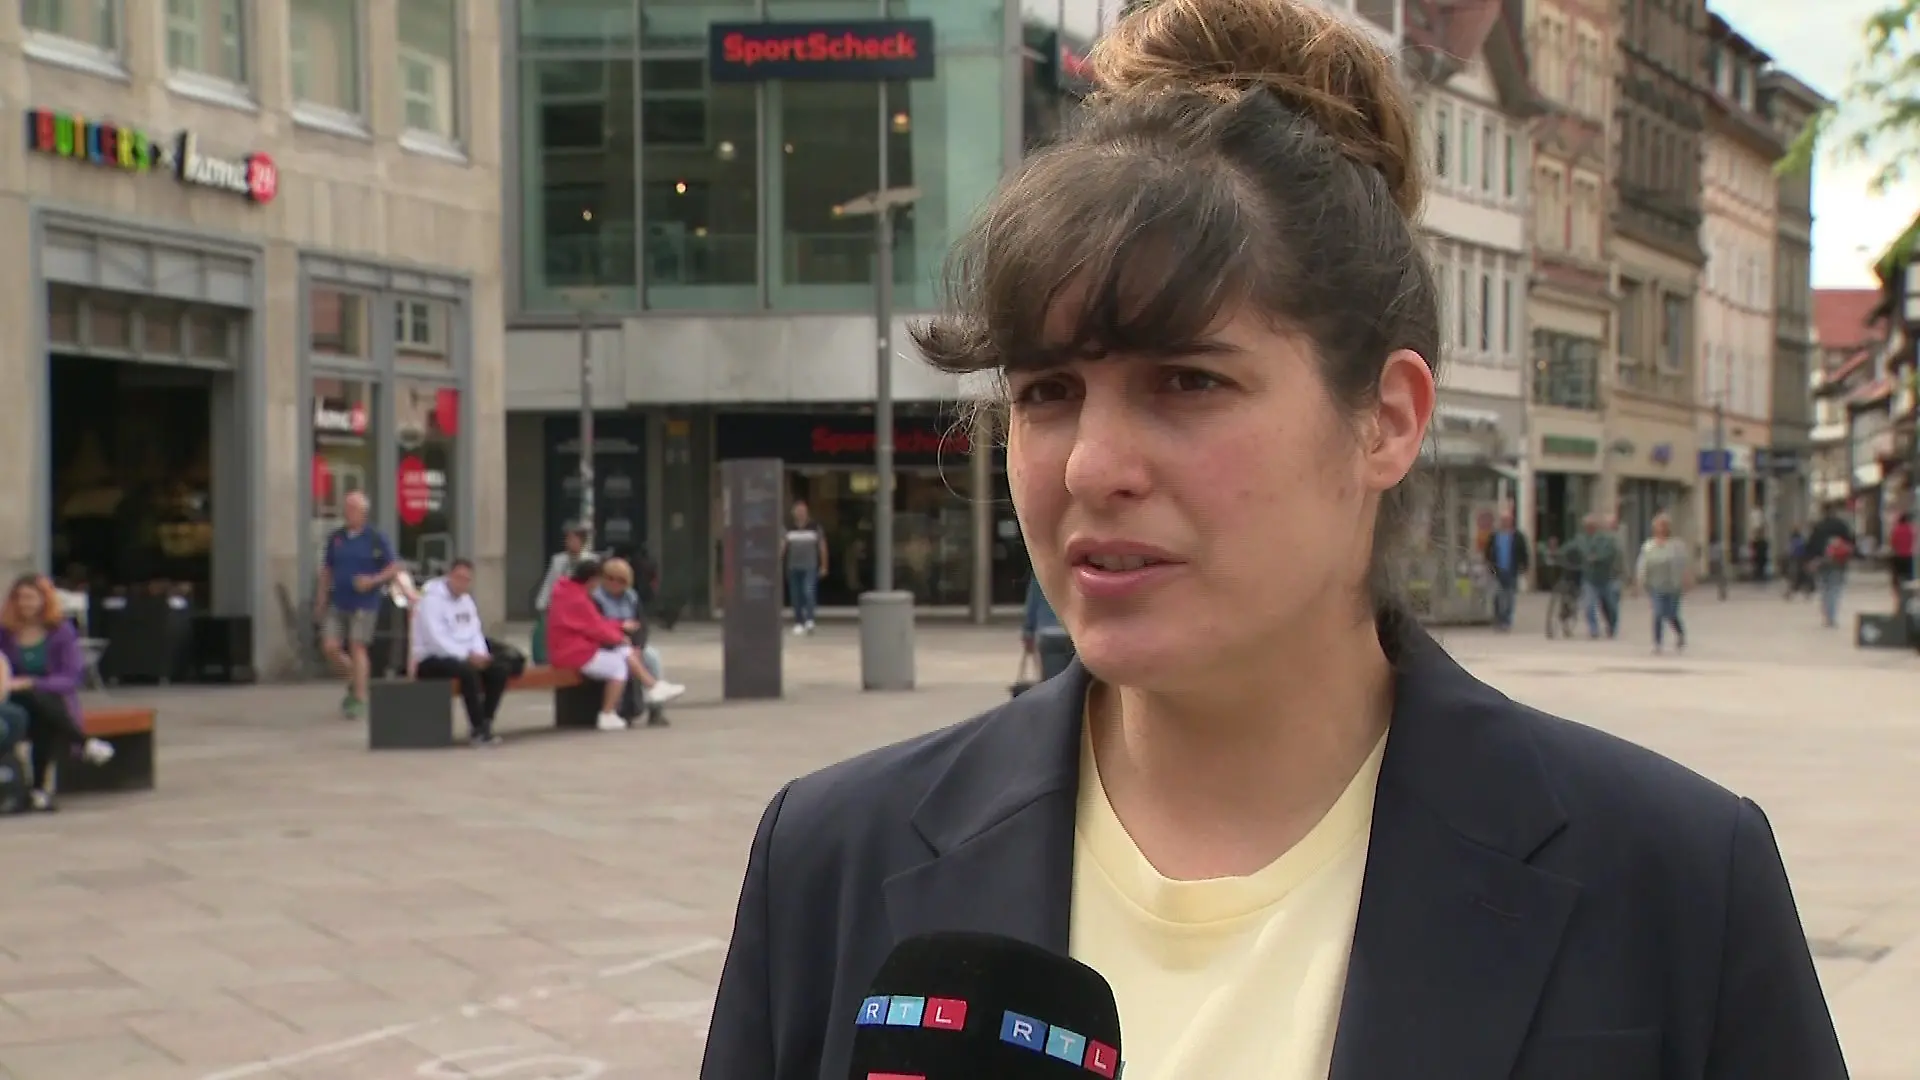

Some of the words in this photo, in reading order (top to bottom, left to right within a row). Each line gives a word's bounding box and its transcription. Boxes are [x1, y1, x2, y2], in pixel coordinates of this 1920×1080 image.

[722, 31, 917, 66] SportScheck
[864, 1001, 954, 1025] RTL
[1012, 1020, 1107, 1070] RTL
